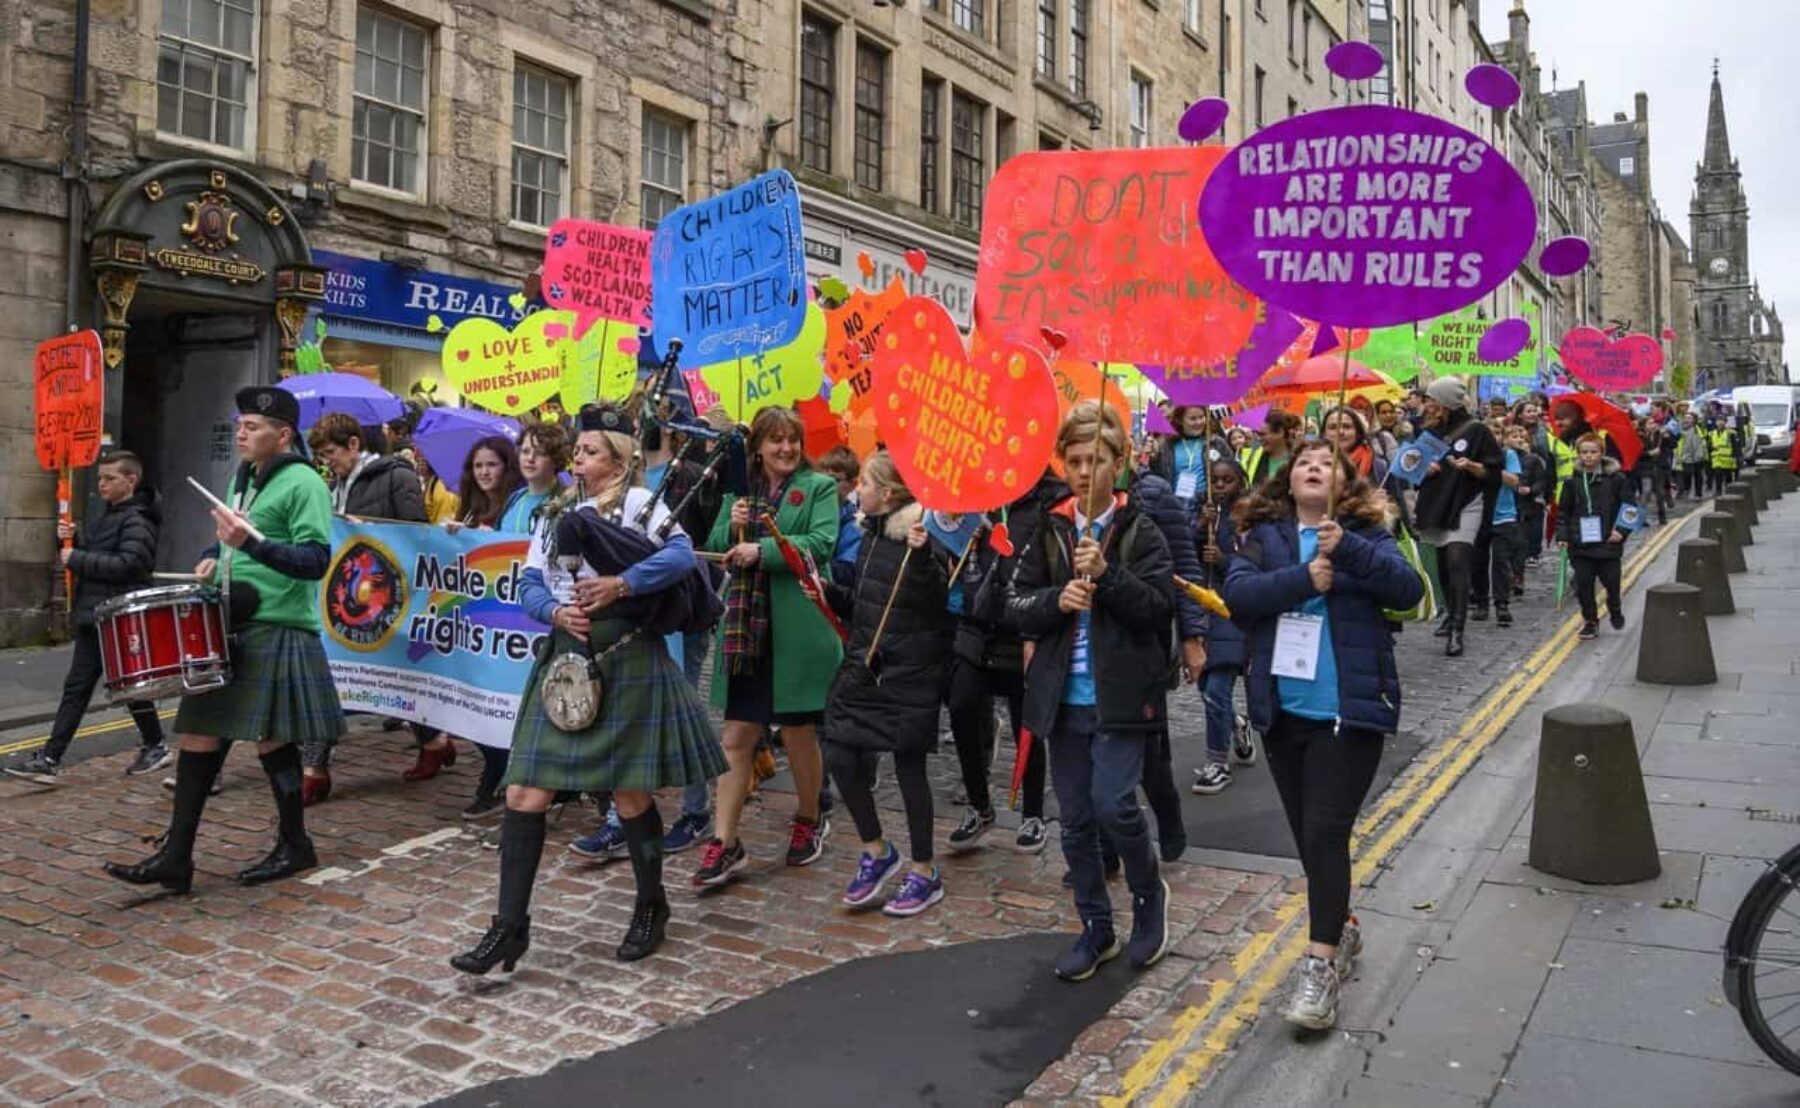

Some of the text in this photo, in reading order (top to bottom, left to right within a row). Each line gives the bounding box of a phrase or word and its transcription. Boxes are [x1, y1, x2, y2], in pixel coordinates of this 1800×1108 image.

[1238, 134, 1486, 176] RELATIONSHIPS
[1284, 171, 1451, 203] ARE MORE
[1254, 205, 1472, 240] IMPORTANT
[576, 228, 653, 258] CHILDREN'
[685, 218, 784, 283] RIGHTS
[326, 271, 367, 290] KIDS
[587, 251, 642, 279] HEALTH
[1257, 250, 1482, 288] THAN RULES
[404, 280, 505, 319] REAL
[571, 286, 633, 317] WEALTH
[843, 312, 864, 338] NO
[1431, 336, 1472, 349] RIGHT
[1443, 322, 1489, 335] WE HAV
[482, 337, 533, 360] LOVE
[1434, 351, 1465, 364] OUR
[745, 364, 783, 404] ACT
[930, 351, 991, 401] MAKE
[897, 363, 1007, 445] CHILDREN'S
[917, 405, 986, 468] RIGHTS
[913, 441, 963, 496] REAL
[415, 554, 486, 598] Make
[410, 604, 485, 655] rights
